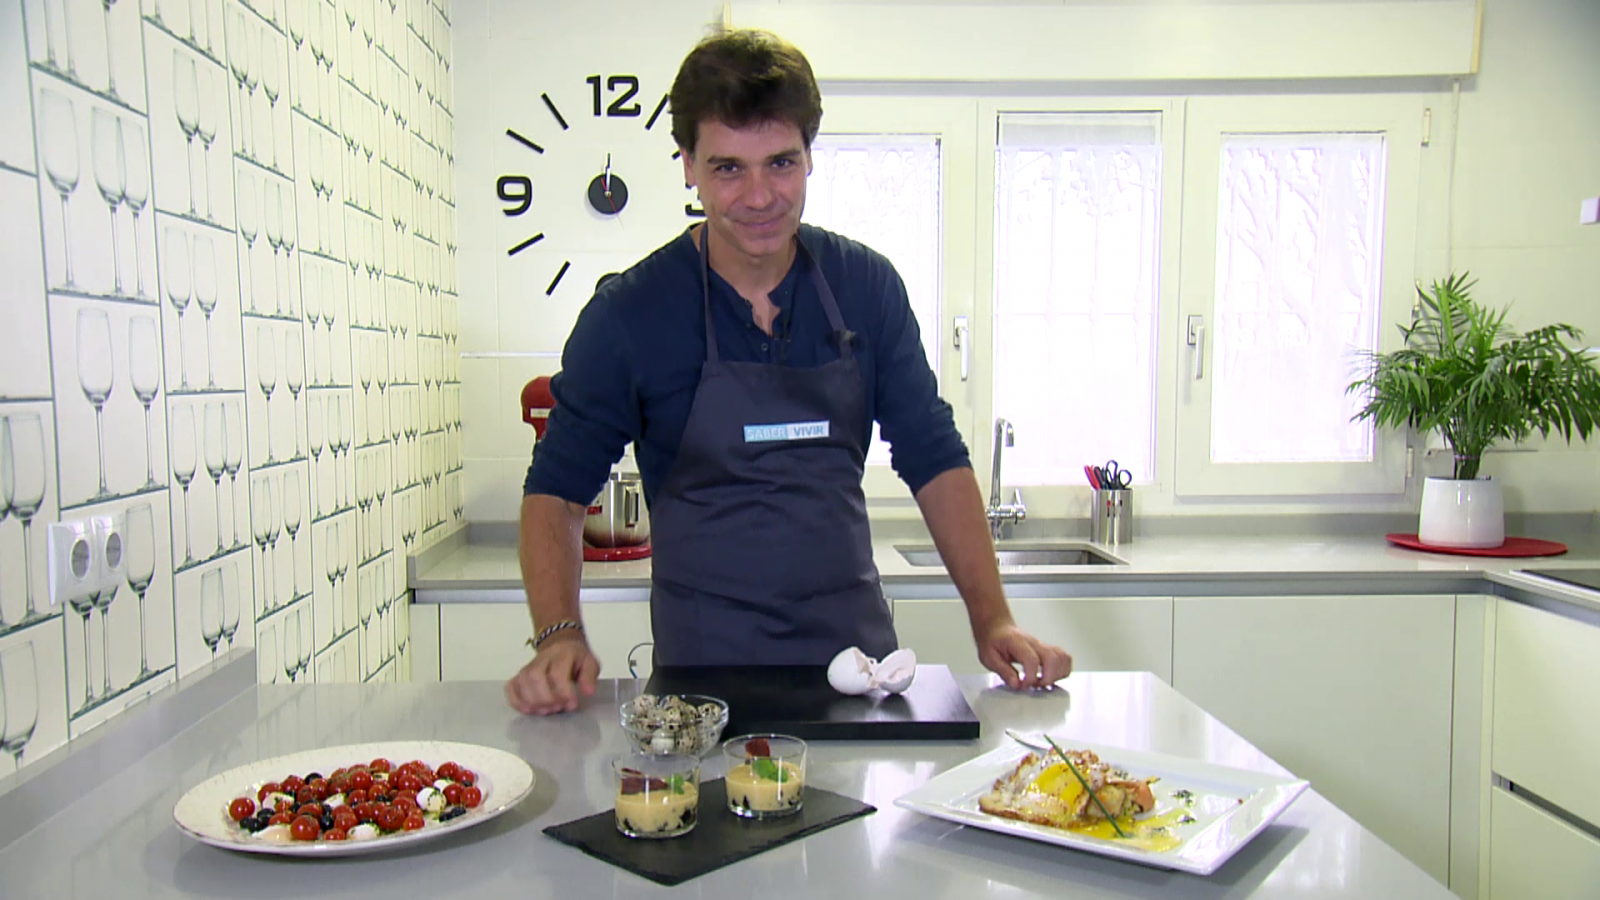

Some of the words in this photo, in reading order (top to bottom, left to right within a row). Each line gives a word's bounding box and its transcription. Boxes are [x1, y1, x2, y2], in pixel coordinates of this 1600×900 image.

[586, 75, 641, 117] 12
[496, 175, 532, 216] 9
[746, 427, 786, 440] SABER
[793, 425, 824, 437] VIVIR
